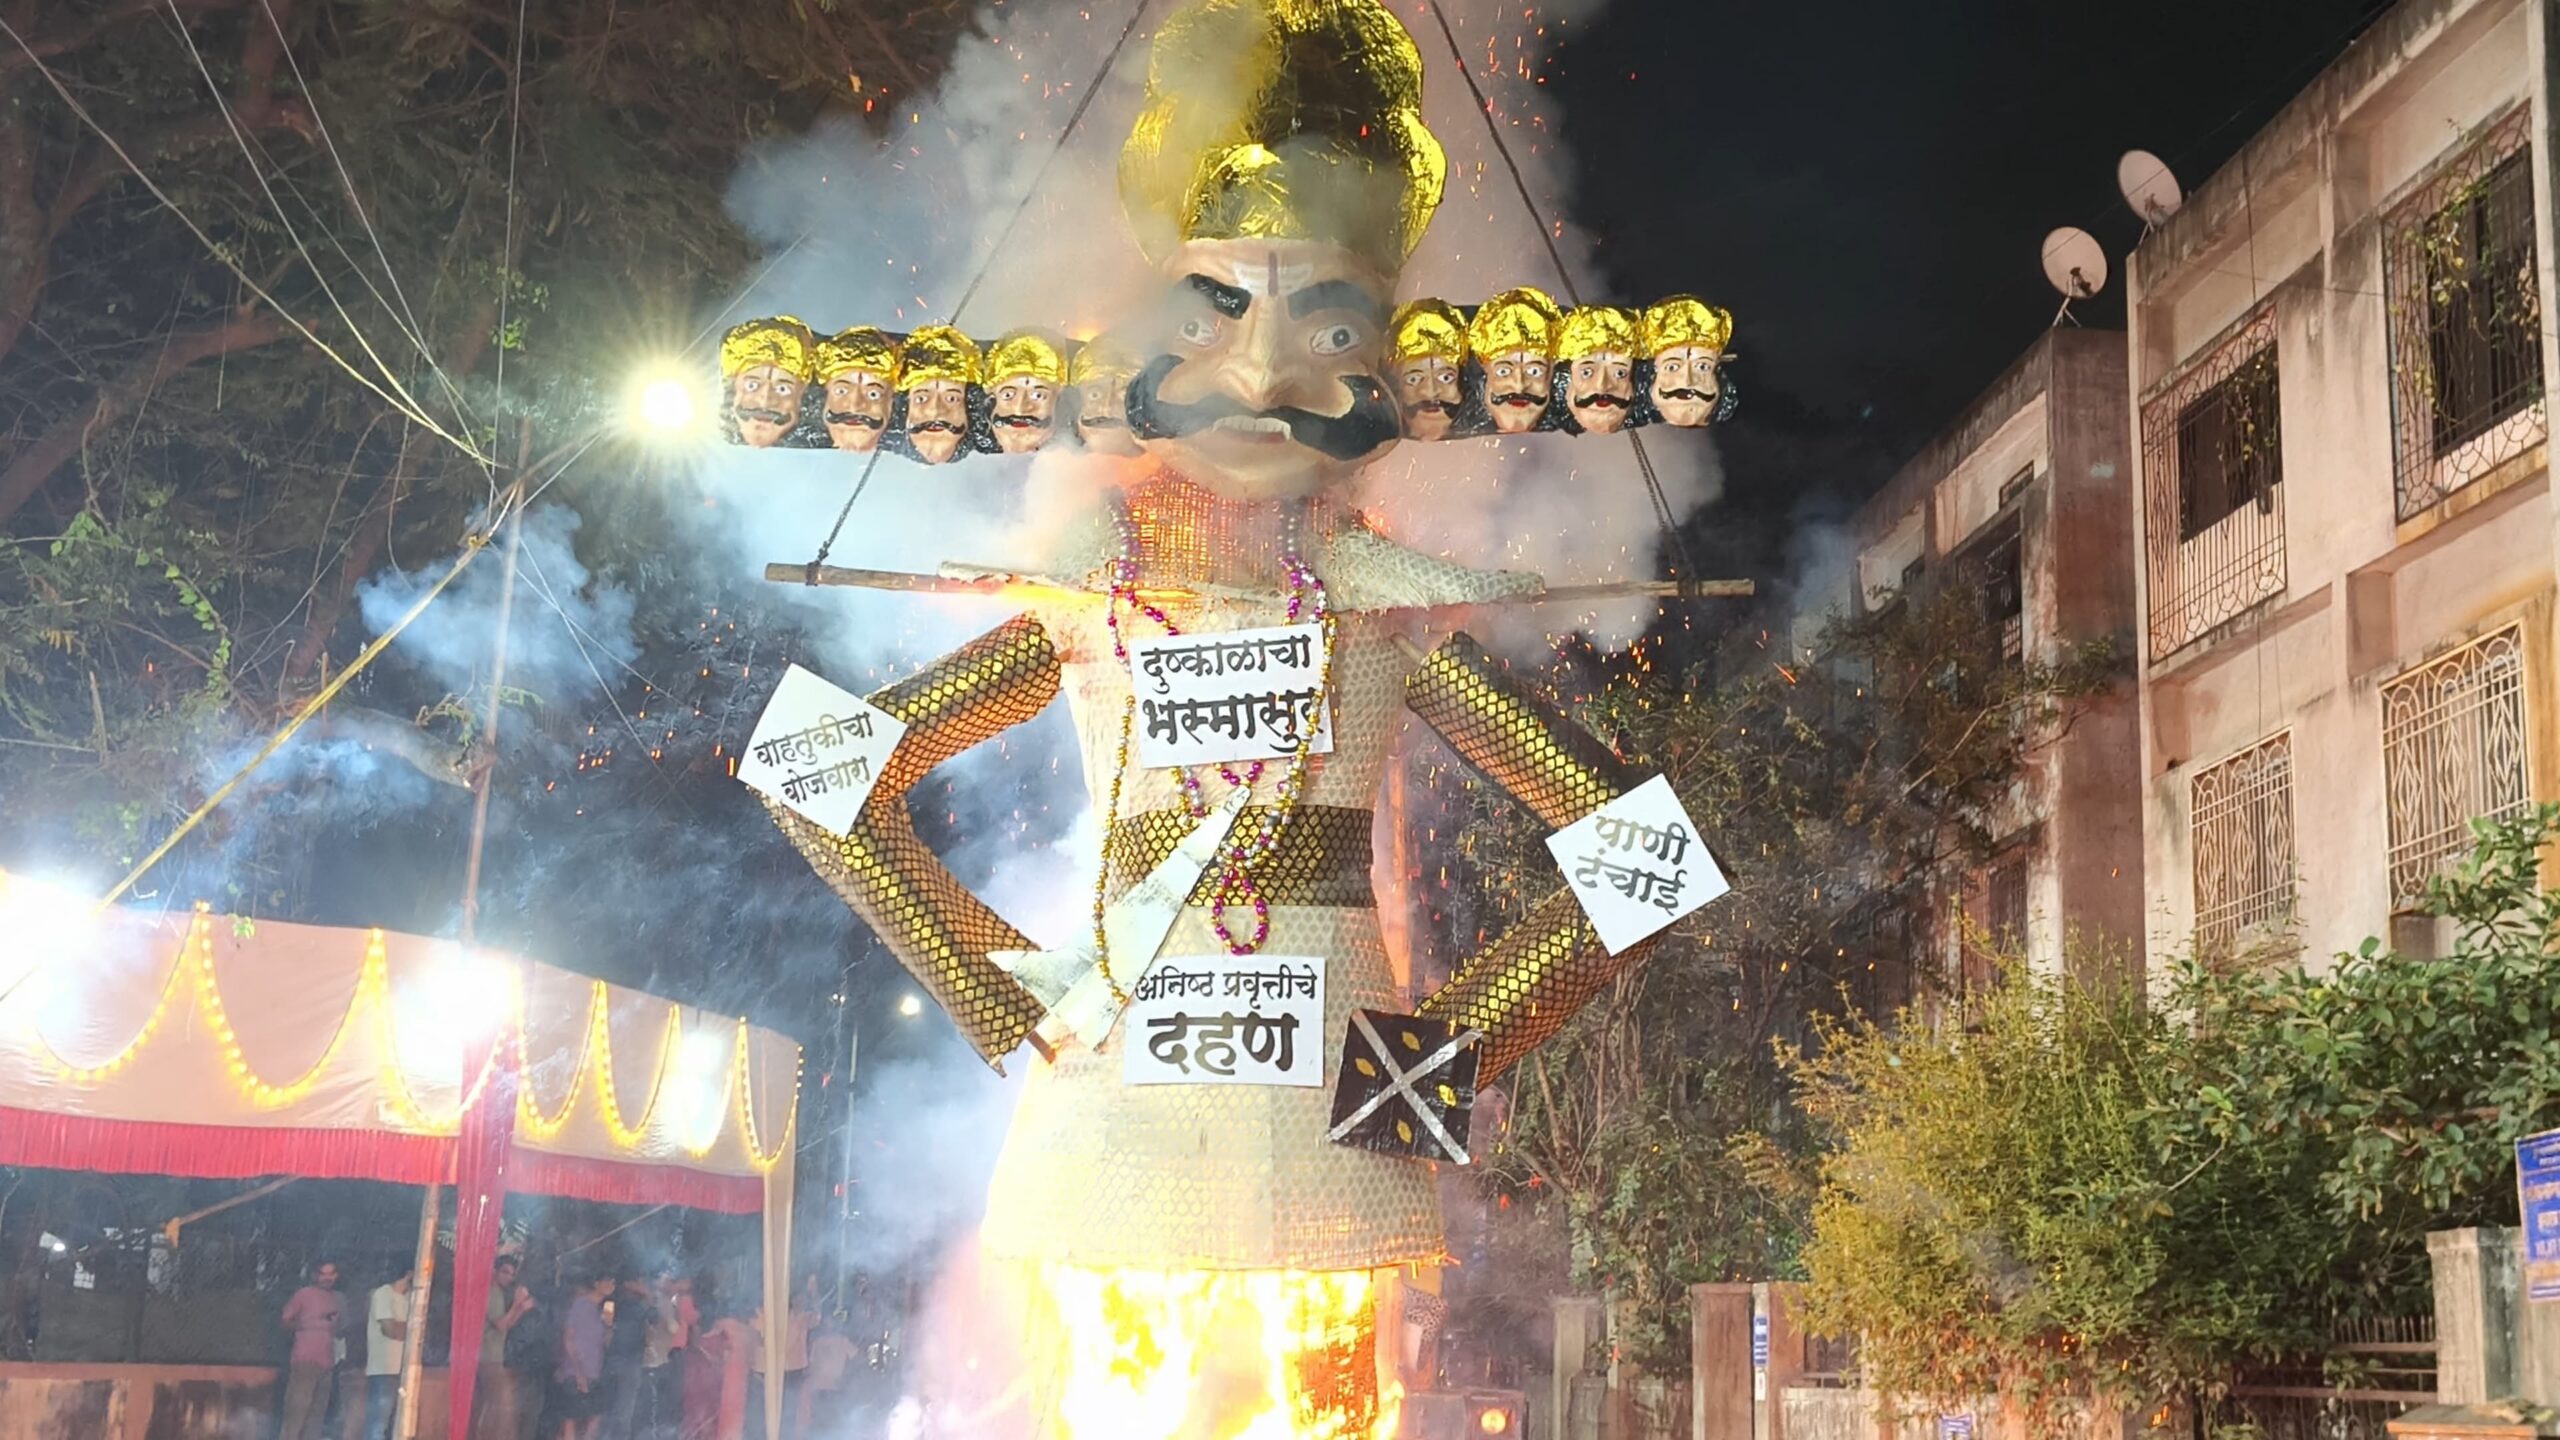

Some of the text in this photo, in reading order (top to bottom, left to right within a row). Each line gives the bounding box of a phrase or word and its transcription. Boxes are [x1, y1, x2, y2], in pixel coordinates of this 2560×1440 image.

[1140, 634, 1312, 694] दुष्काळाचा
[753, 711, 873, 767] वाहतुकीचा
[781, 756, 870, 803] बोजवारा
[1595, 815, 1691, 866] पाणी
[1575, 847, 1688, 917] टंचाई
[1135, 964, 1318, 1009] अनिष्ठ प्रवृत्तीचे
[1147, 1011, 1300, 1075] दहण
